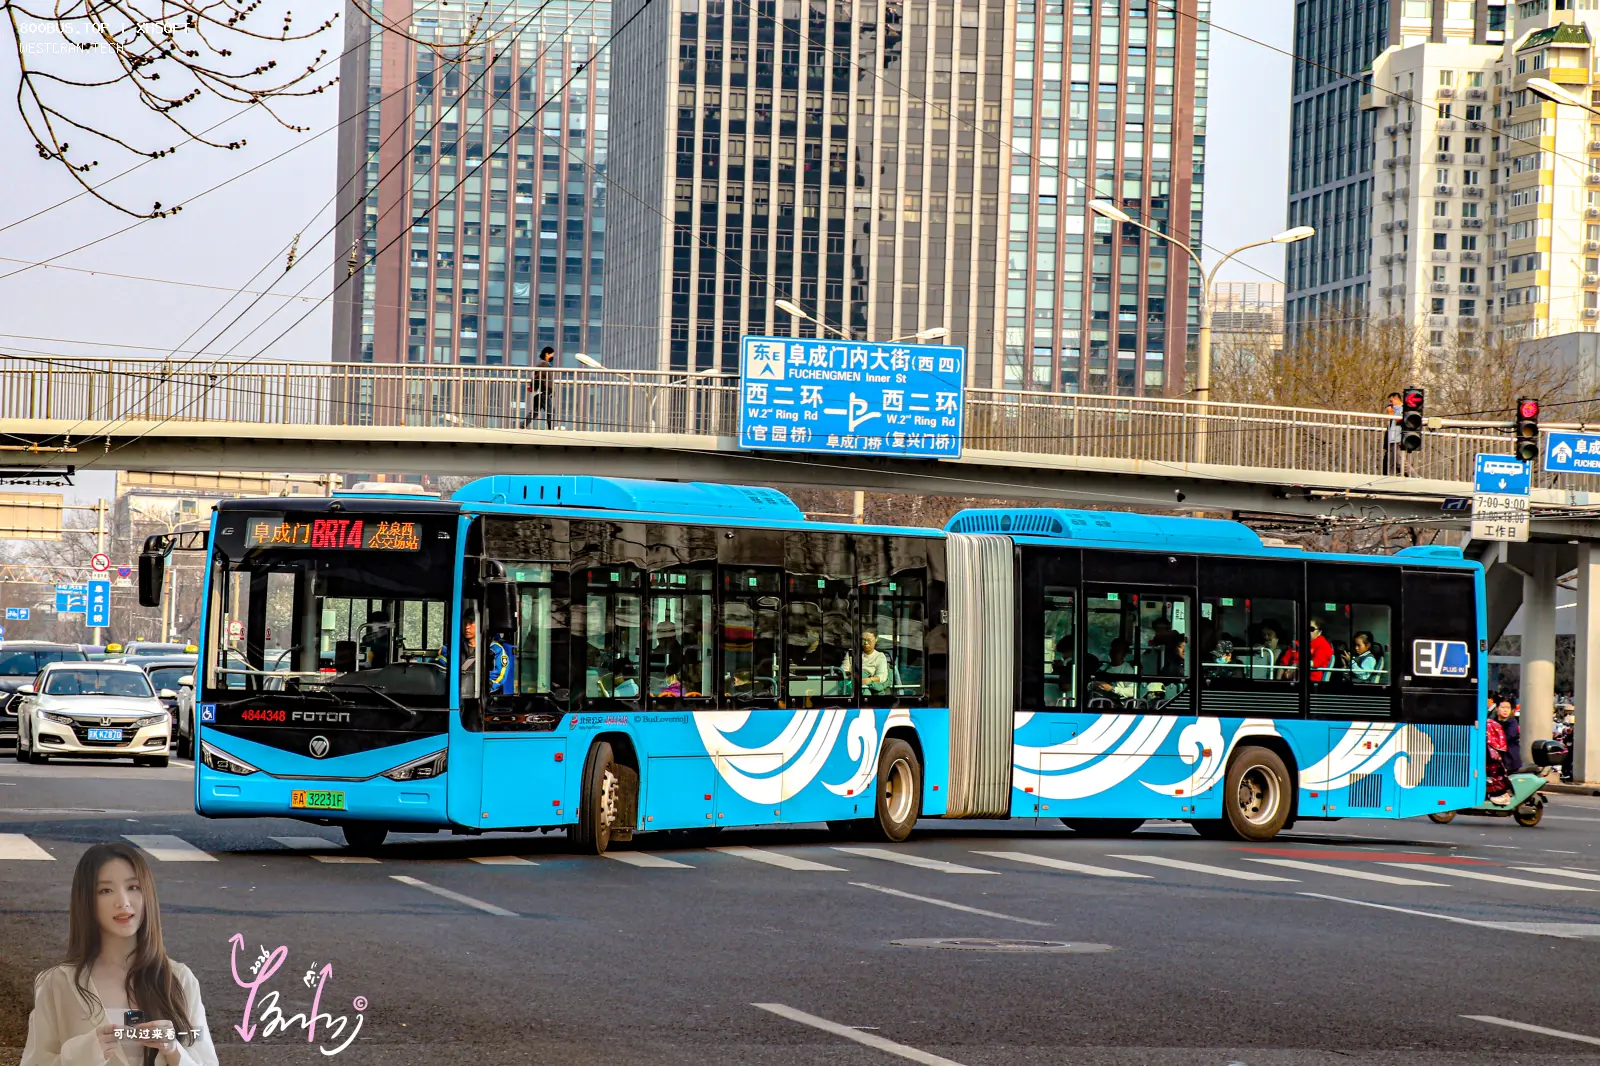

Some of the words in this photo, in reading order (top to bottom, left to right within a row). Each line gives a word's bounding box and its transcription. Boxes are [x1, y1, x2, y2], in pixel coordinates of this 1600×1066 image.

[753, 343, 771, 361] 东
[772, 353, 781, 361] E
[789, 369, 861, 382] FUCHENGMEN
[865, 372, 891, 383] Inner
[895, 373, 907, 384] St
[746, 382, 824, 408] 西二环
[882, 389, 959, 415] 西二环
[775, 409, 799, 422] Ring
[804, 410, 819, 421] Rd
[914, 415, 937, 428] Ring
[941, 416, 956, 427] Rd
[826, 433, 882, 450] 阜成门桥
[252, 522, 310, 544] 阜成门
[311, 519, 364, 548] BRT4
[1484, 525, 1516, 538] 工作日
[241, 709, 287, 722] 4844348
[291, 711, 351, 723] FOTON
